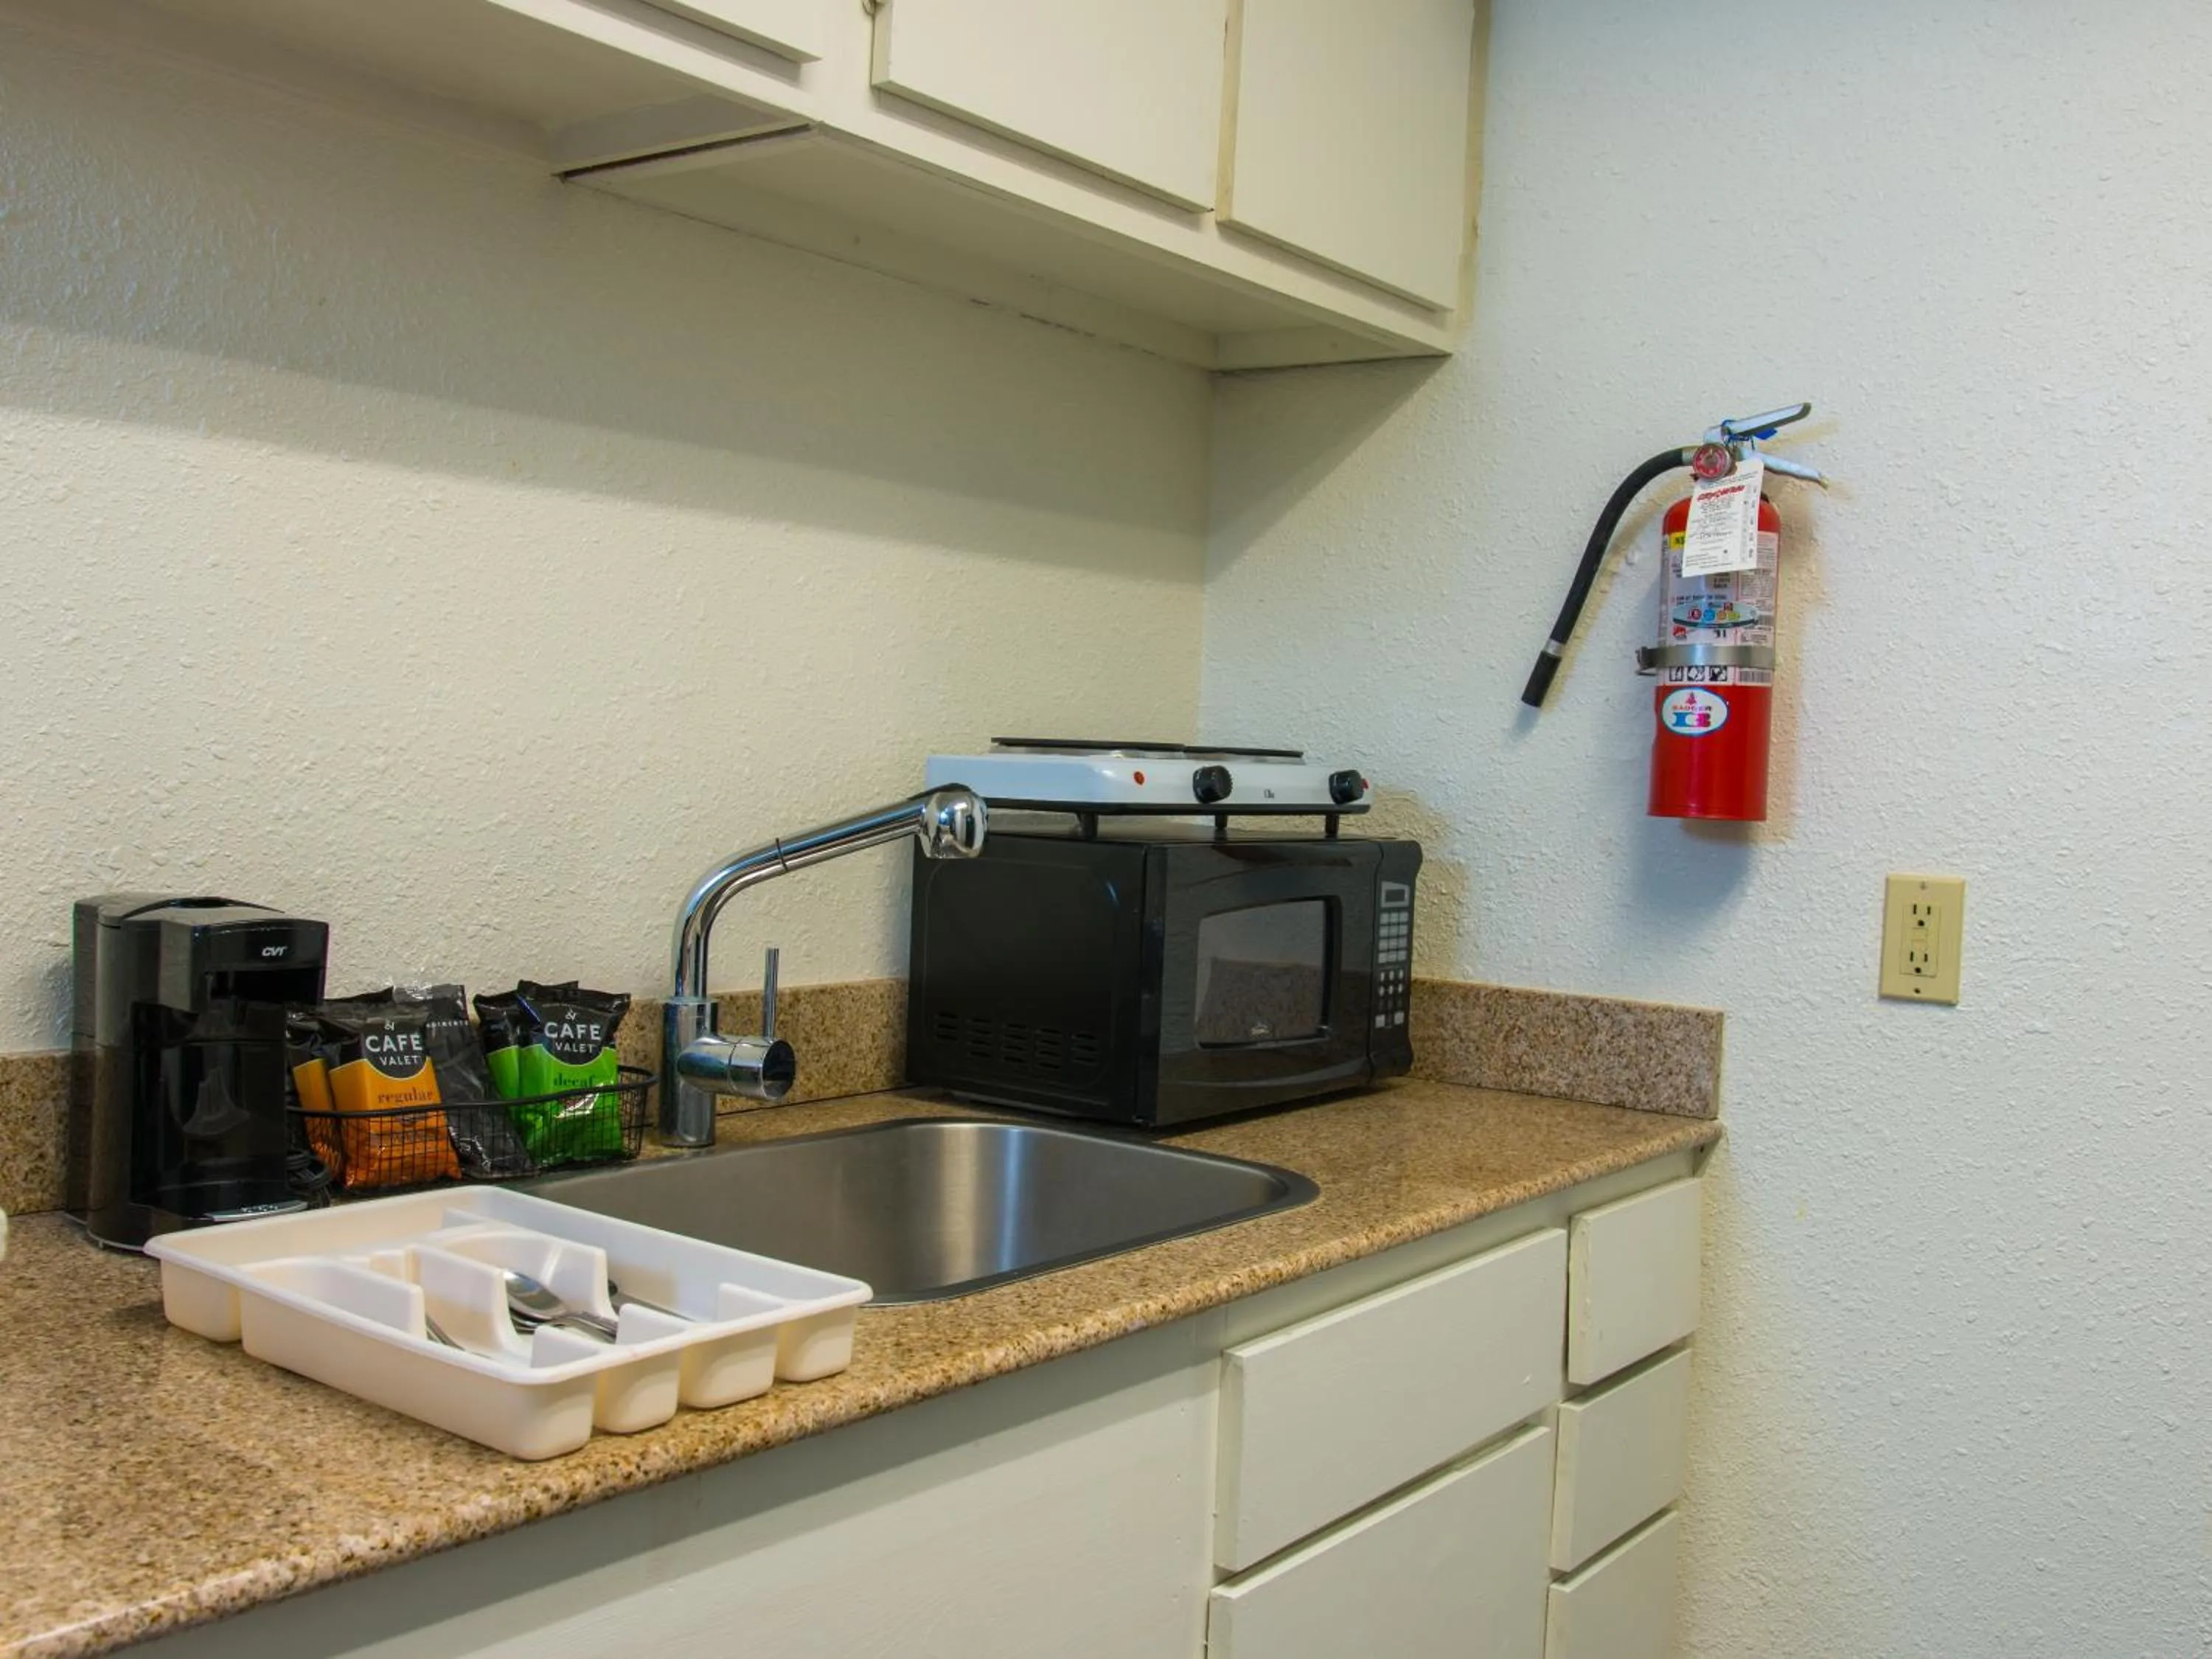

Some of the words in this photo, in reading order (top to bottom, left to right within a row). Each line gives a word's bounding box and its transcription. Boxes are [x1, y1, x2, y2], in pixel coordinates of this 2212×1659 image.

[554, 1041, 594, 1054] VALET
[379, 1055, 420, 1066] VALET
[553, 1073, 597, 1088] decaf
[378, 1087, 434, 1104] regular
